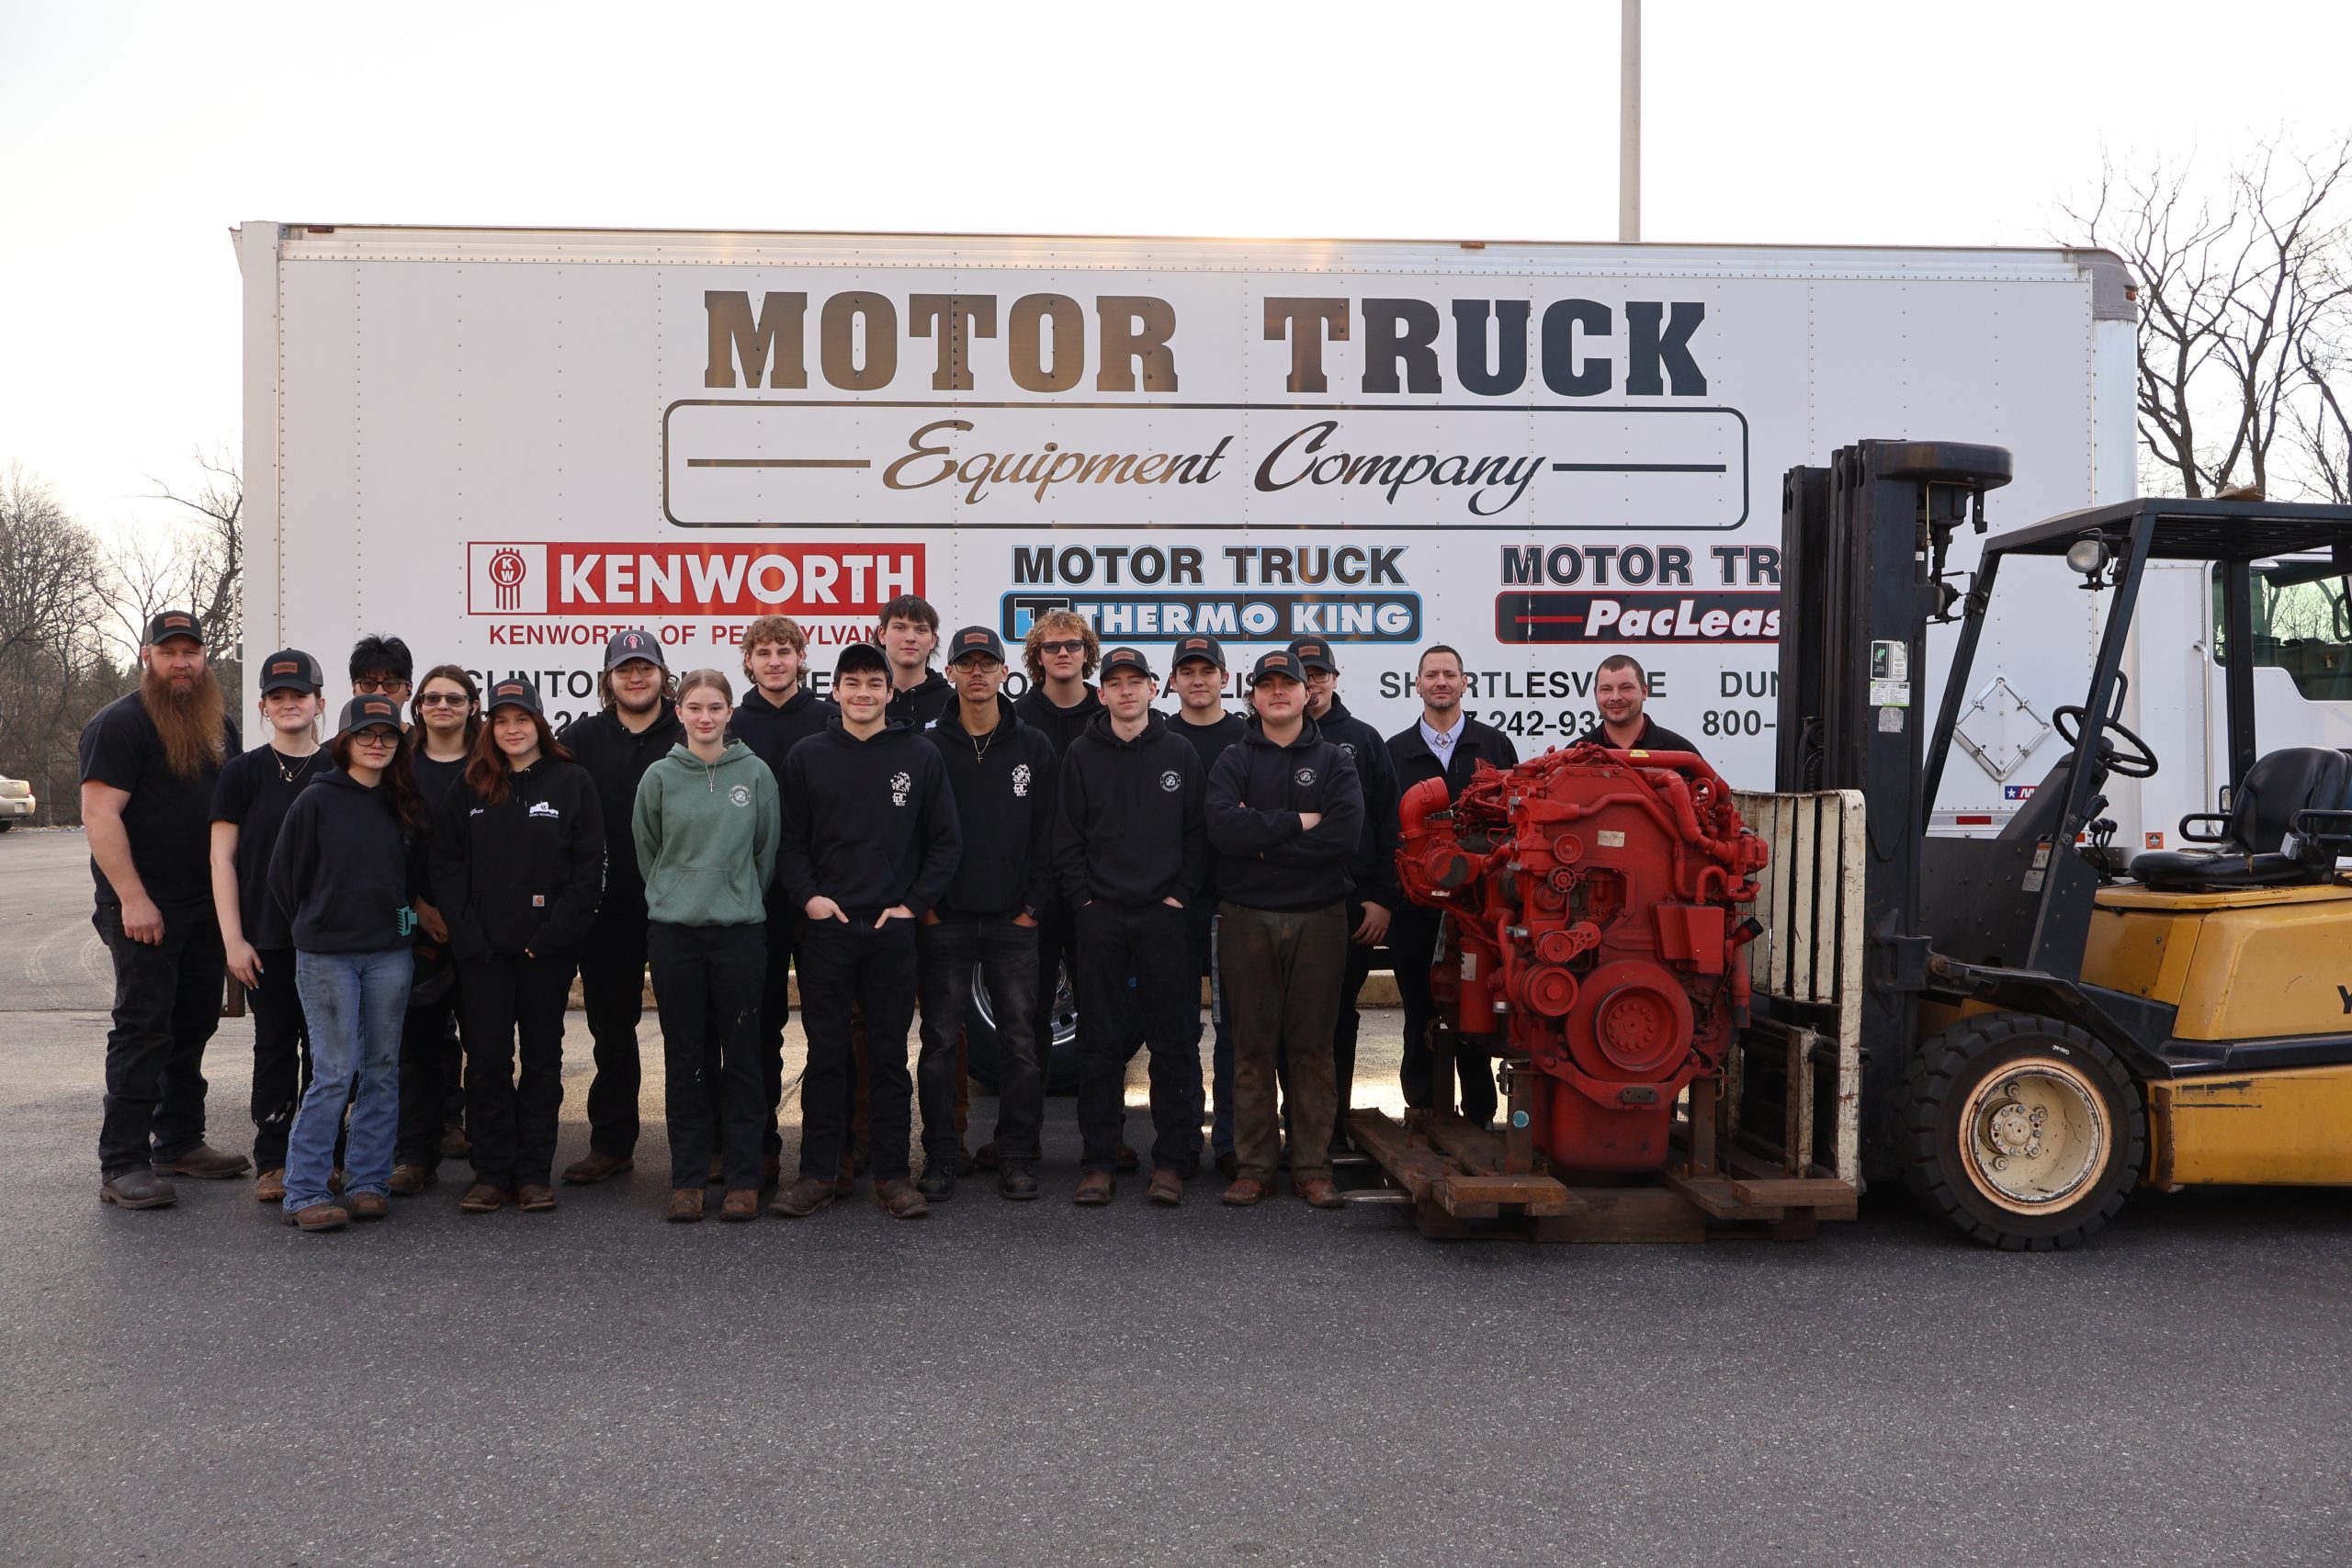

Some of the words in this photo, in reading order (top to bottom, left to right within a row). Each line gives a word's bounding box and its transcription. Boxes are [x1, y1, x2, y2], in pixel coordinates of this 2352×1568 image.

[705, 290, 1178, 393] MOTOR
[1263, 297, 1707, 397] TRUCK
[882, 420, 1234, 504] Equipment
[1254, 420, 1546, 516] Company
[560, 554, 915, 604] KENWORTH
[1012, 545, 1204, 586] MOTOR
[1223, 545, 1409, 586] TRUCK
[1500, 544, 1693, 586] MOTOR
[1711, 545, 1781, 586] TR
[661, 625, 695, 645] OF
[1075, 602, 1278, 636] THERMO
[1291, 602, 1413, 635] KING
[1584, 599, 1781, 637] PacLeas
